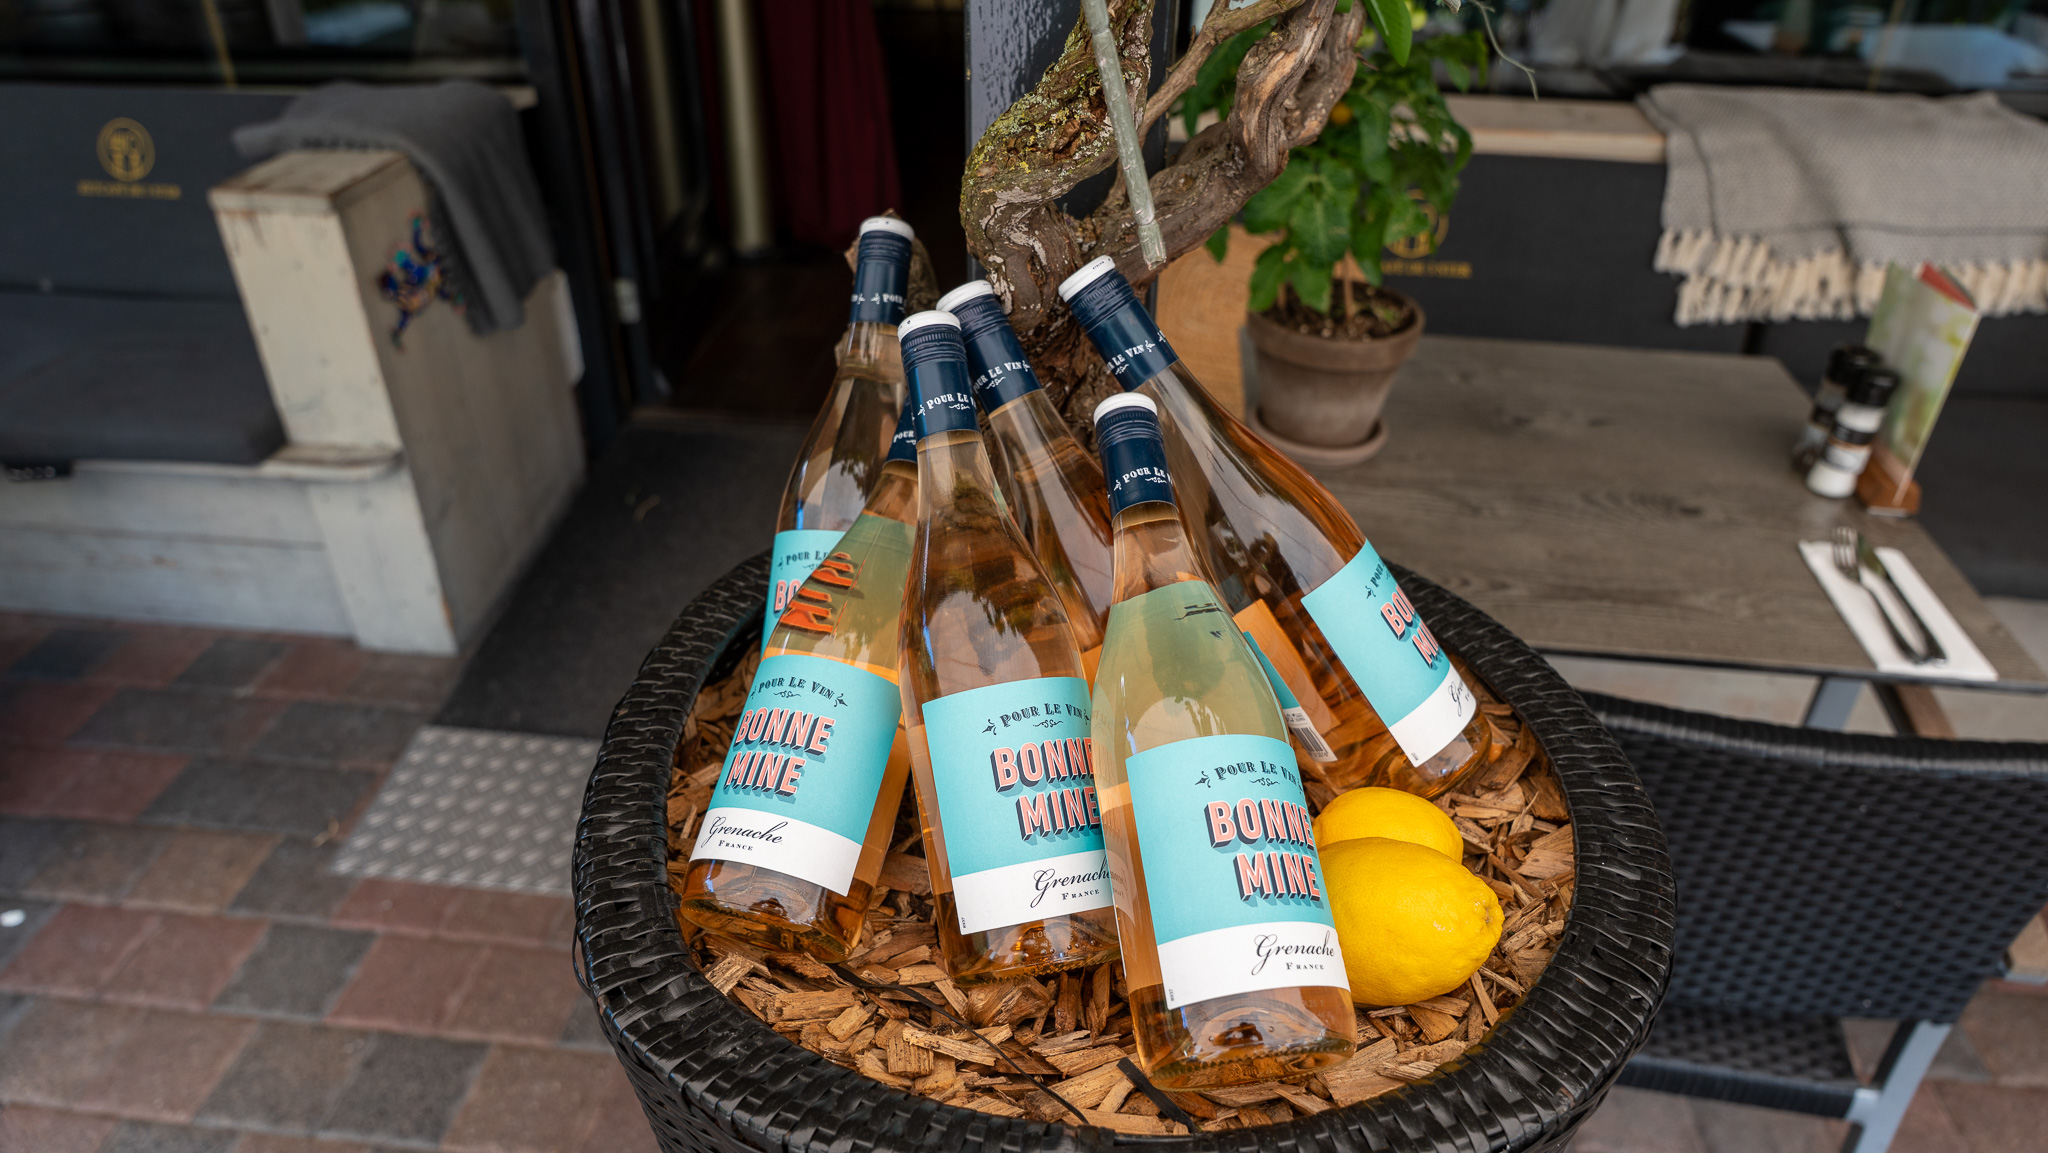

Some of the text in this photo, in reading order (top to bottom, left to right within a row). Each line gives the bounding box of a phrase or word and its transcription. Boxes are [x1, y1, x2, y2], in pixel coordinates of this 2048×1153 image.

[1112, 353, 1126, 366] LE
[1125, 344, 1144, 357] VIN
[988, 366, 1003, 378] LE
[1004, 361, 1022, 371] VIN
[926, 393, 955, 410] POUR
[956, 392, 969, 403] LE
[1122, 467, 1151, 483] POUR
[1153, 466, 1166, 478] LE
[786, 551, 810, 565] POUR
[758, 676, 834, 700] POUR LE VIN
[1000, 703, 1083, 728] POUR LE VIN
[733, 707, 836, 756] BONNE
[723, 751, 806, 797] MINE
[1214, 760, 1298, 786] POUR LE VIN
[1015, 786, 1101, 841] MINE
[1204, 798, 1315, 850] BONNE
[701, 816, 788, 848] Grenache
[718, 839, 753, 851] FRANCE
[1233, 852, 1321, 901] MINE
[1061, 889, 1100, 901] FRANCE
[1251, 930, 1335, 976] Grenache
[1285, 962, 1325, 971] FRANCE
